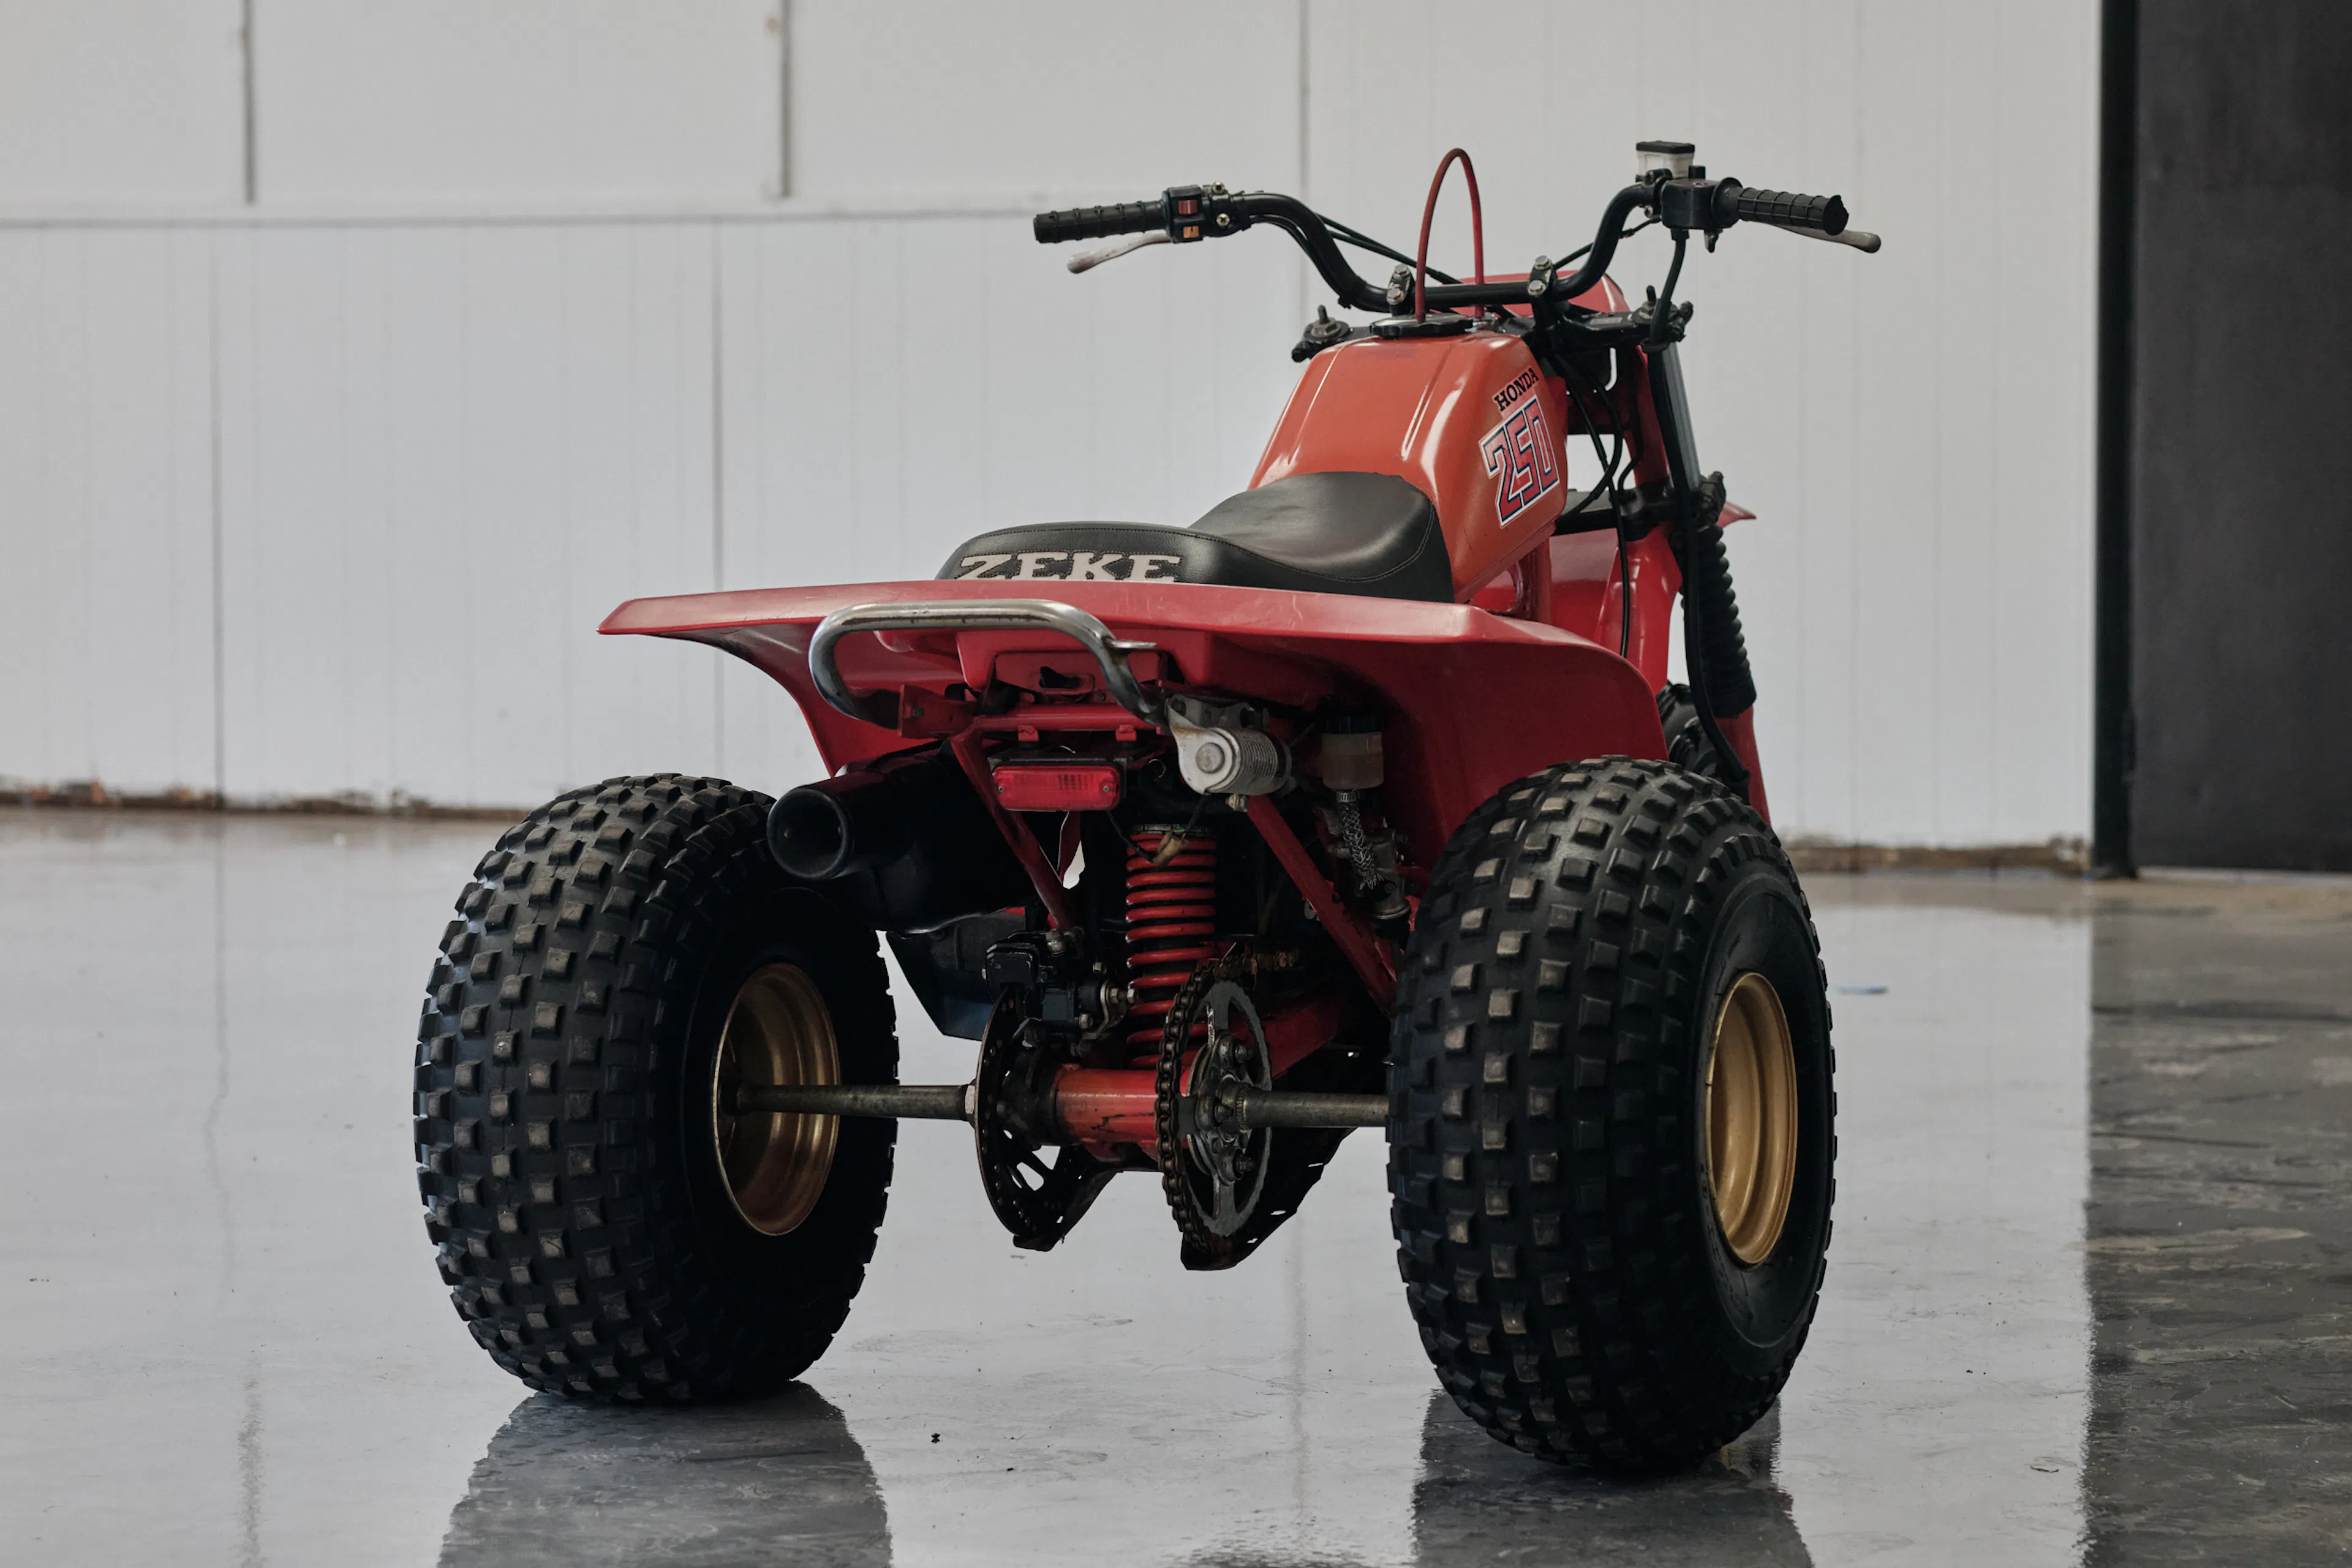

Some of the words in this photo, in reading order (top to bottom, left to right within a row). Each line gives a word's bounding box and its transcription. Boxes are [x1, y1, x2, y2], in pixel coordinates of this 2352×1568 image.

[1493, 367, 1539, 412] HONDA
[1480, 395, 1560, 526] 250
[954, 551, 1182, 582] ZEKE
